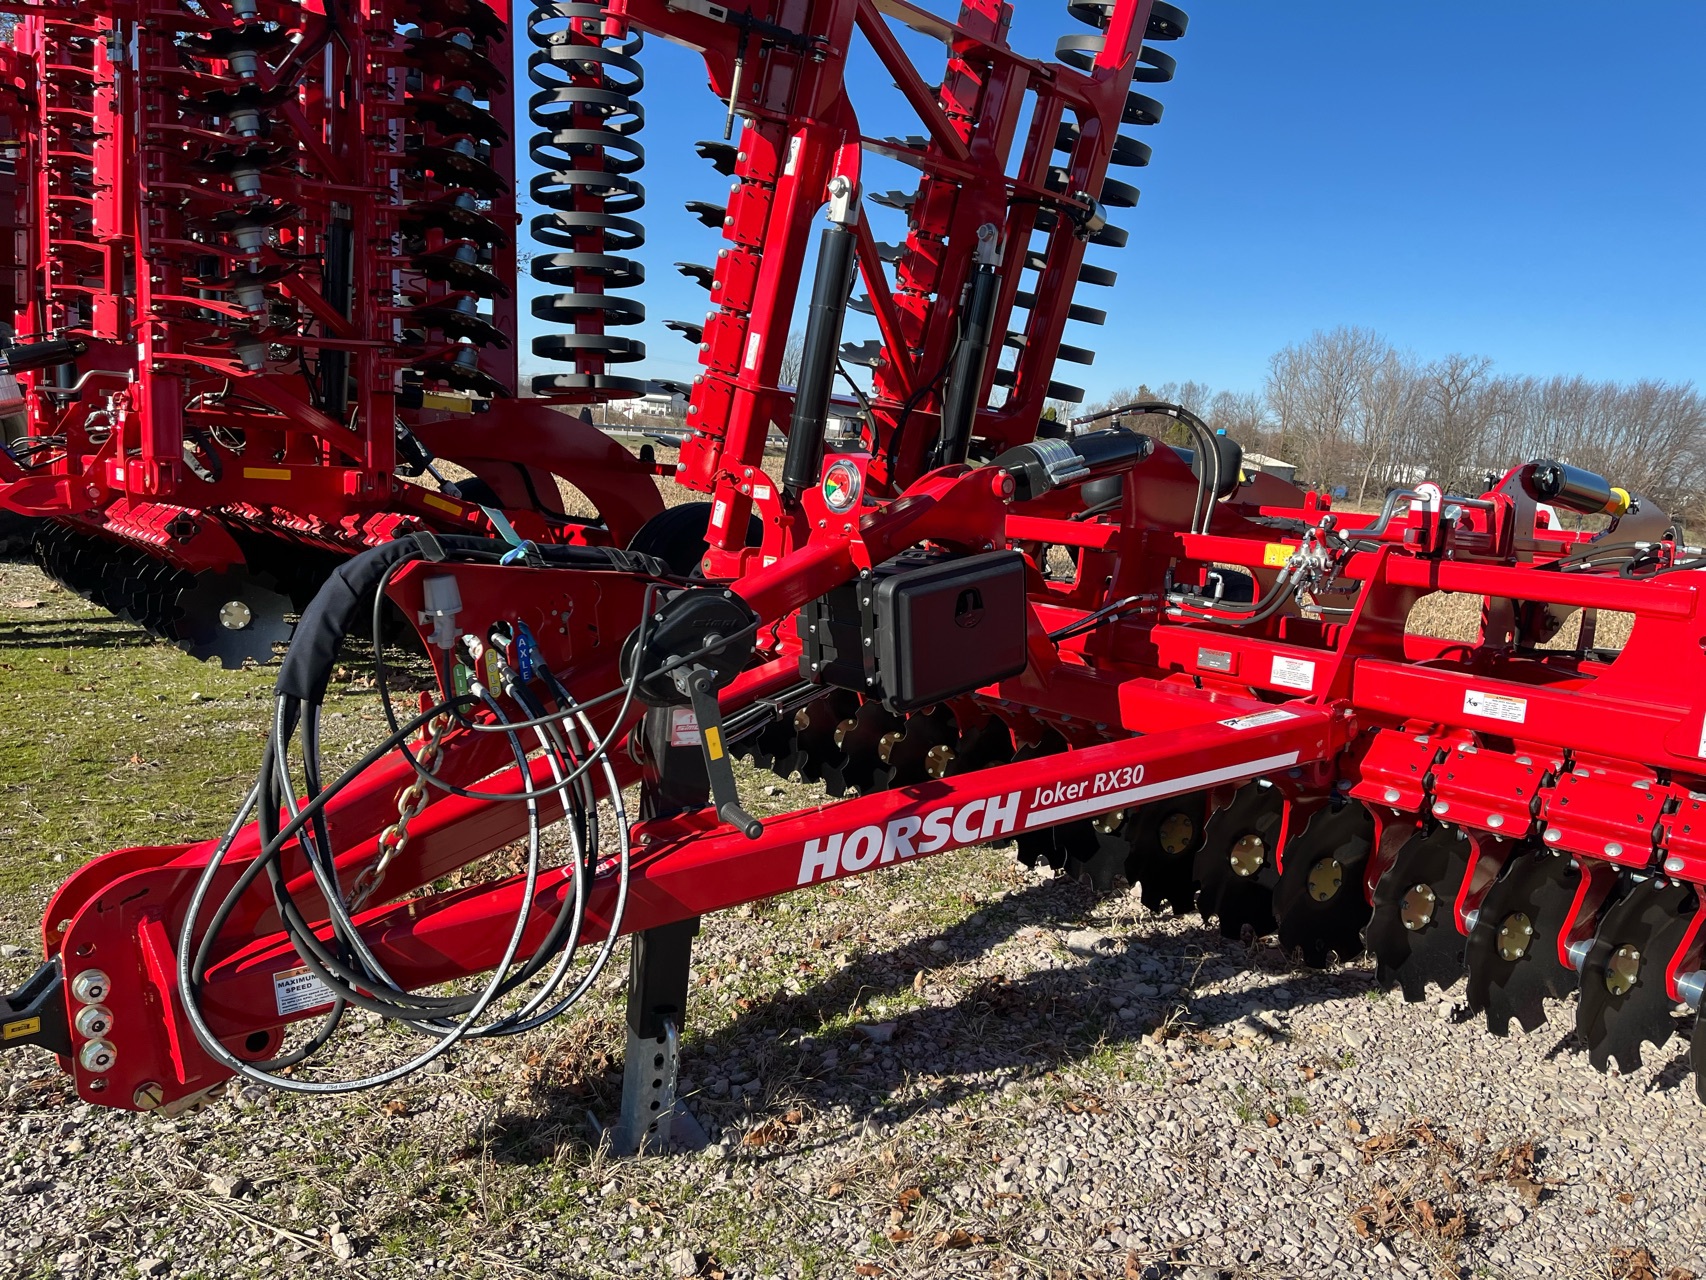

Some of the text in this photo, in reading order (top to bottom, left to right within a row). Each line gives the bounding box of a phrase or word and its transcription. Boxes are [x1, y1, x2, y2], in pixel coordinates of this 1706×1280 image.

[488, 652, 500, 695] FOLD
[518, 638, 530, 680] AXLE
[1030, 764, 1144, 808] Joker RX30
[797, 790, 1021, 885] HORSCH
[286, 983, 312, 993] SPEED
